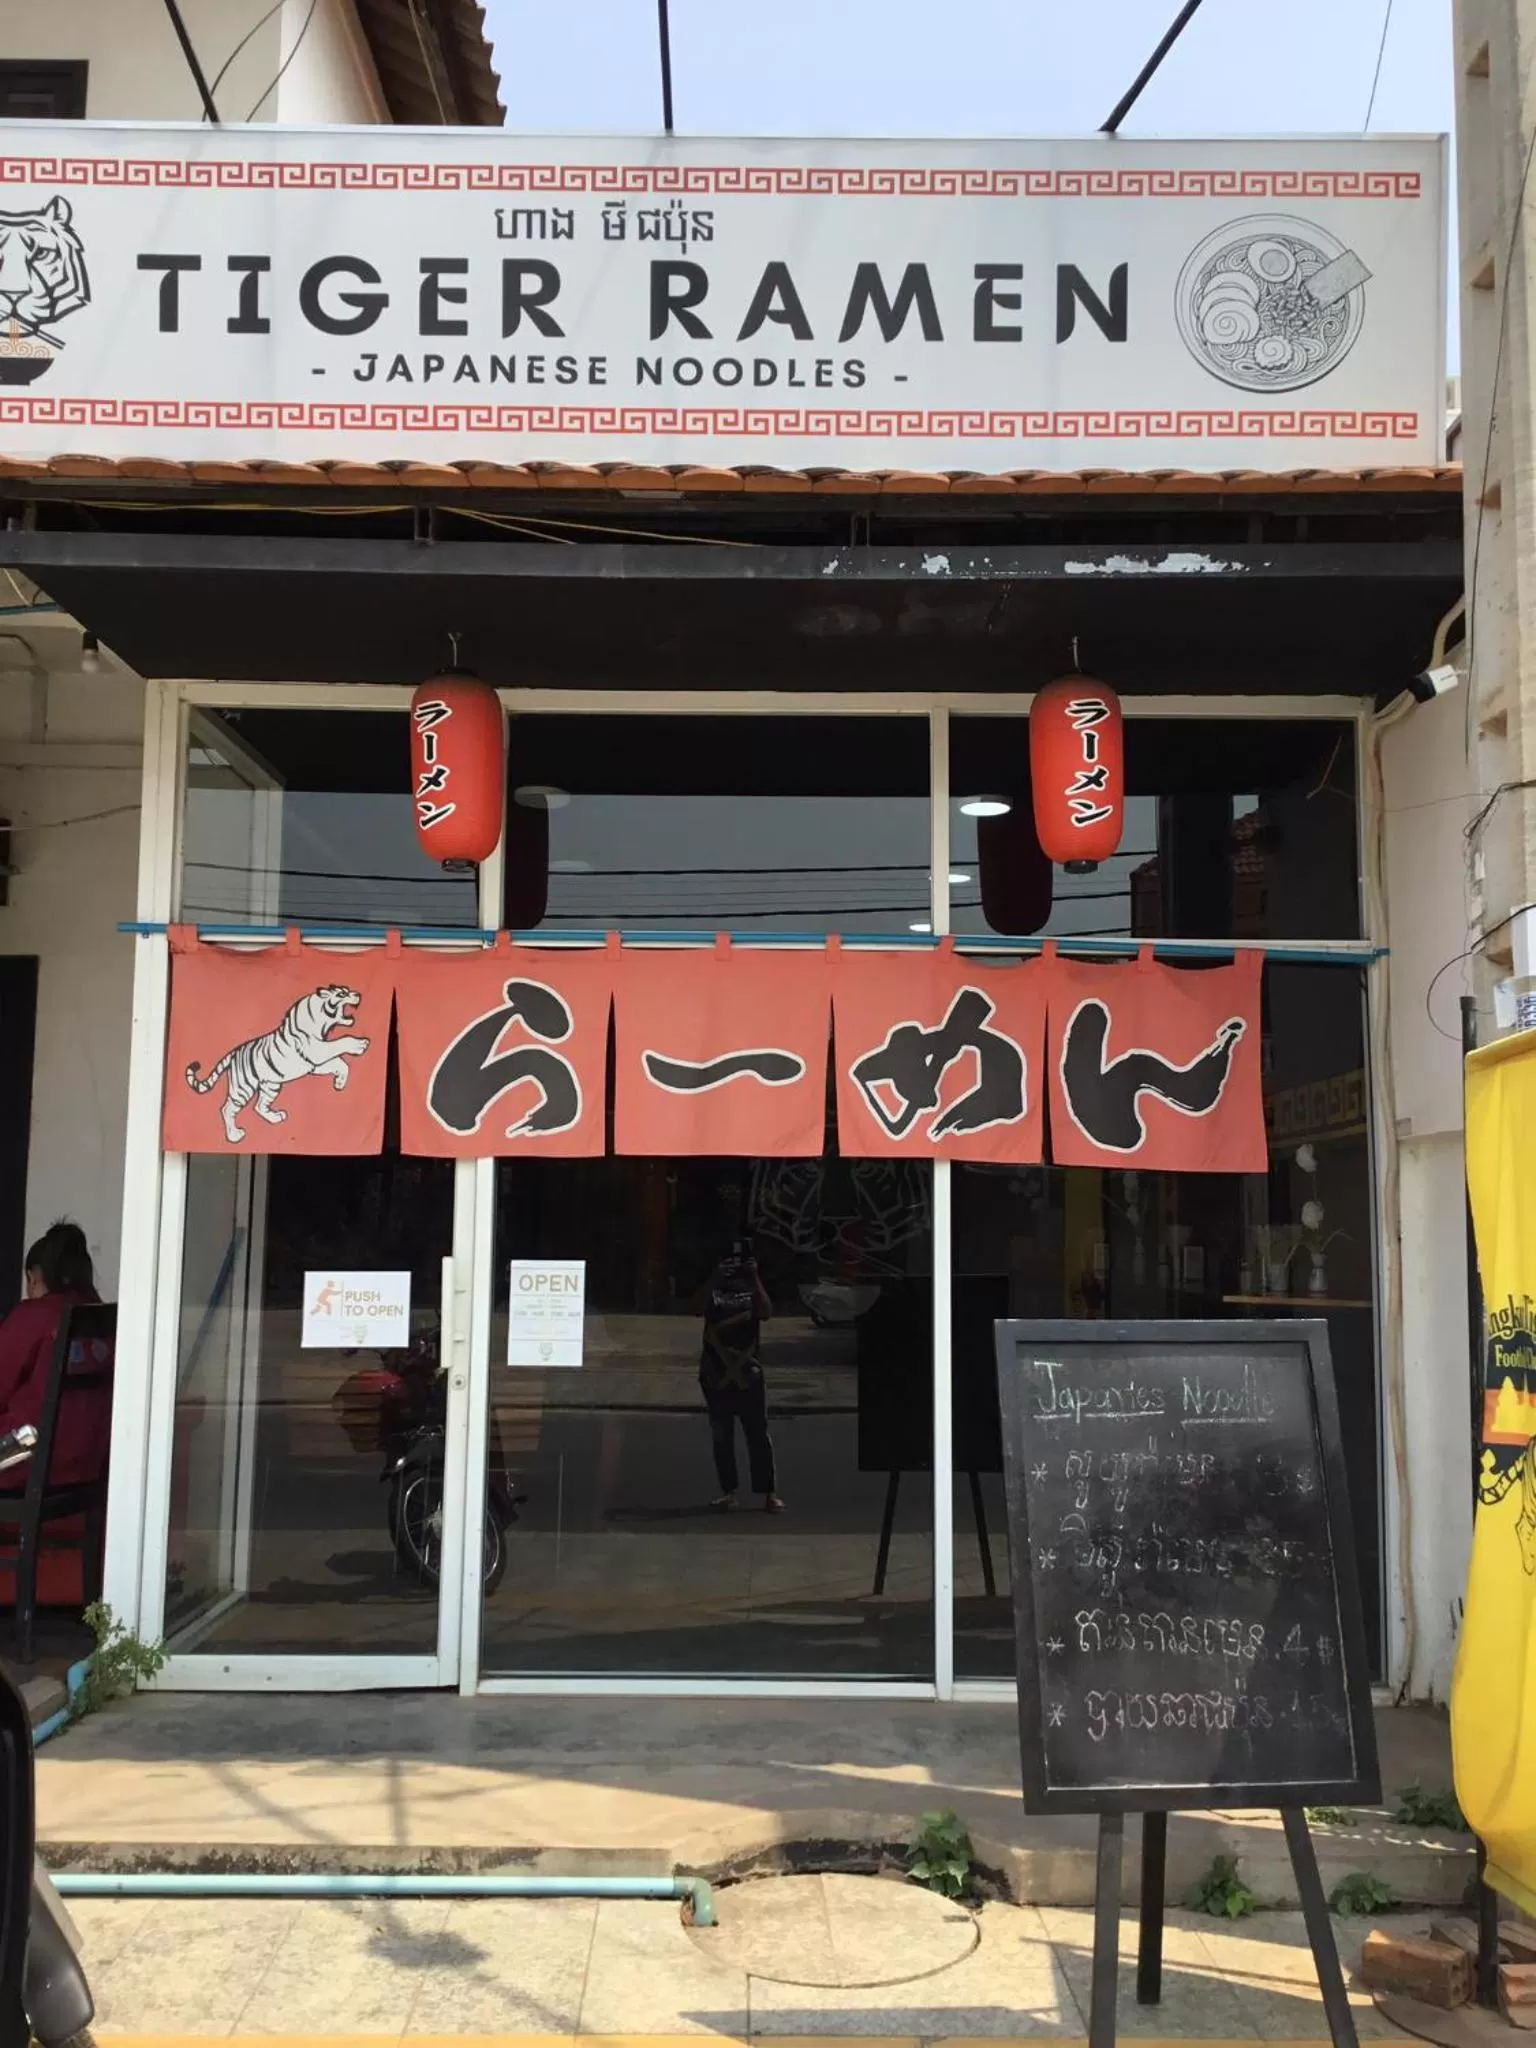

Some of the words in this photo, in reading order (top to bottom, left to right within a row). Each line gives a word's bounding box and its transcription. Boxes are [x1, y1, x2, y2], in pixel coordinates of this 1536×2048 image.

[494, 206, 575, 240] ហាង
[136, 253, 566, 339] TIGER
[649, 257, 1129, 345] RAMEN
[353, 352, 608, 386] JAPANESE
[636, 356, 867, 390] NOODLES
[415, 701, 456, 831] ラーメン
[1064, 699, 1114, 827] ラーメン
[345, 1289, 381, 1303] PUSH
[518, 1273, 579, 1293] OPEN
[344, 1304, 365, 1317] TO
[366, 1304, 405, 1317] OPEN
